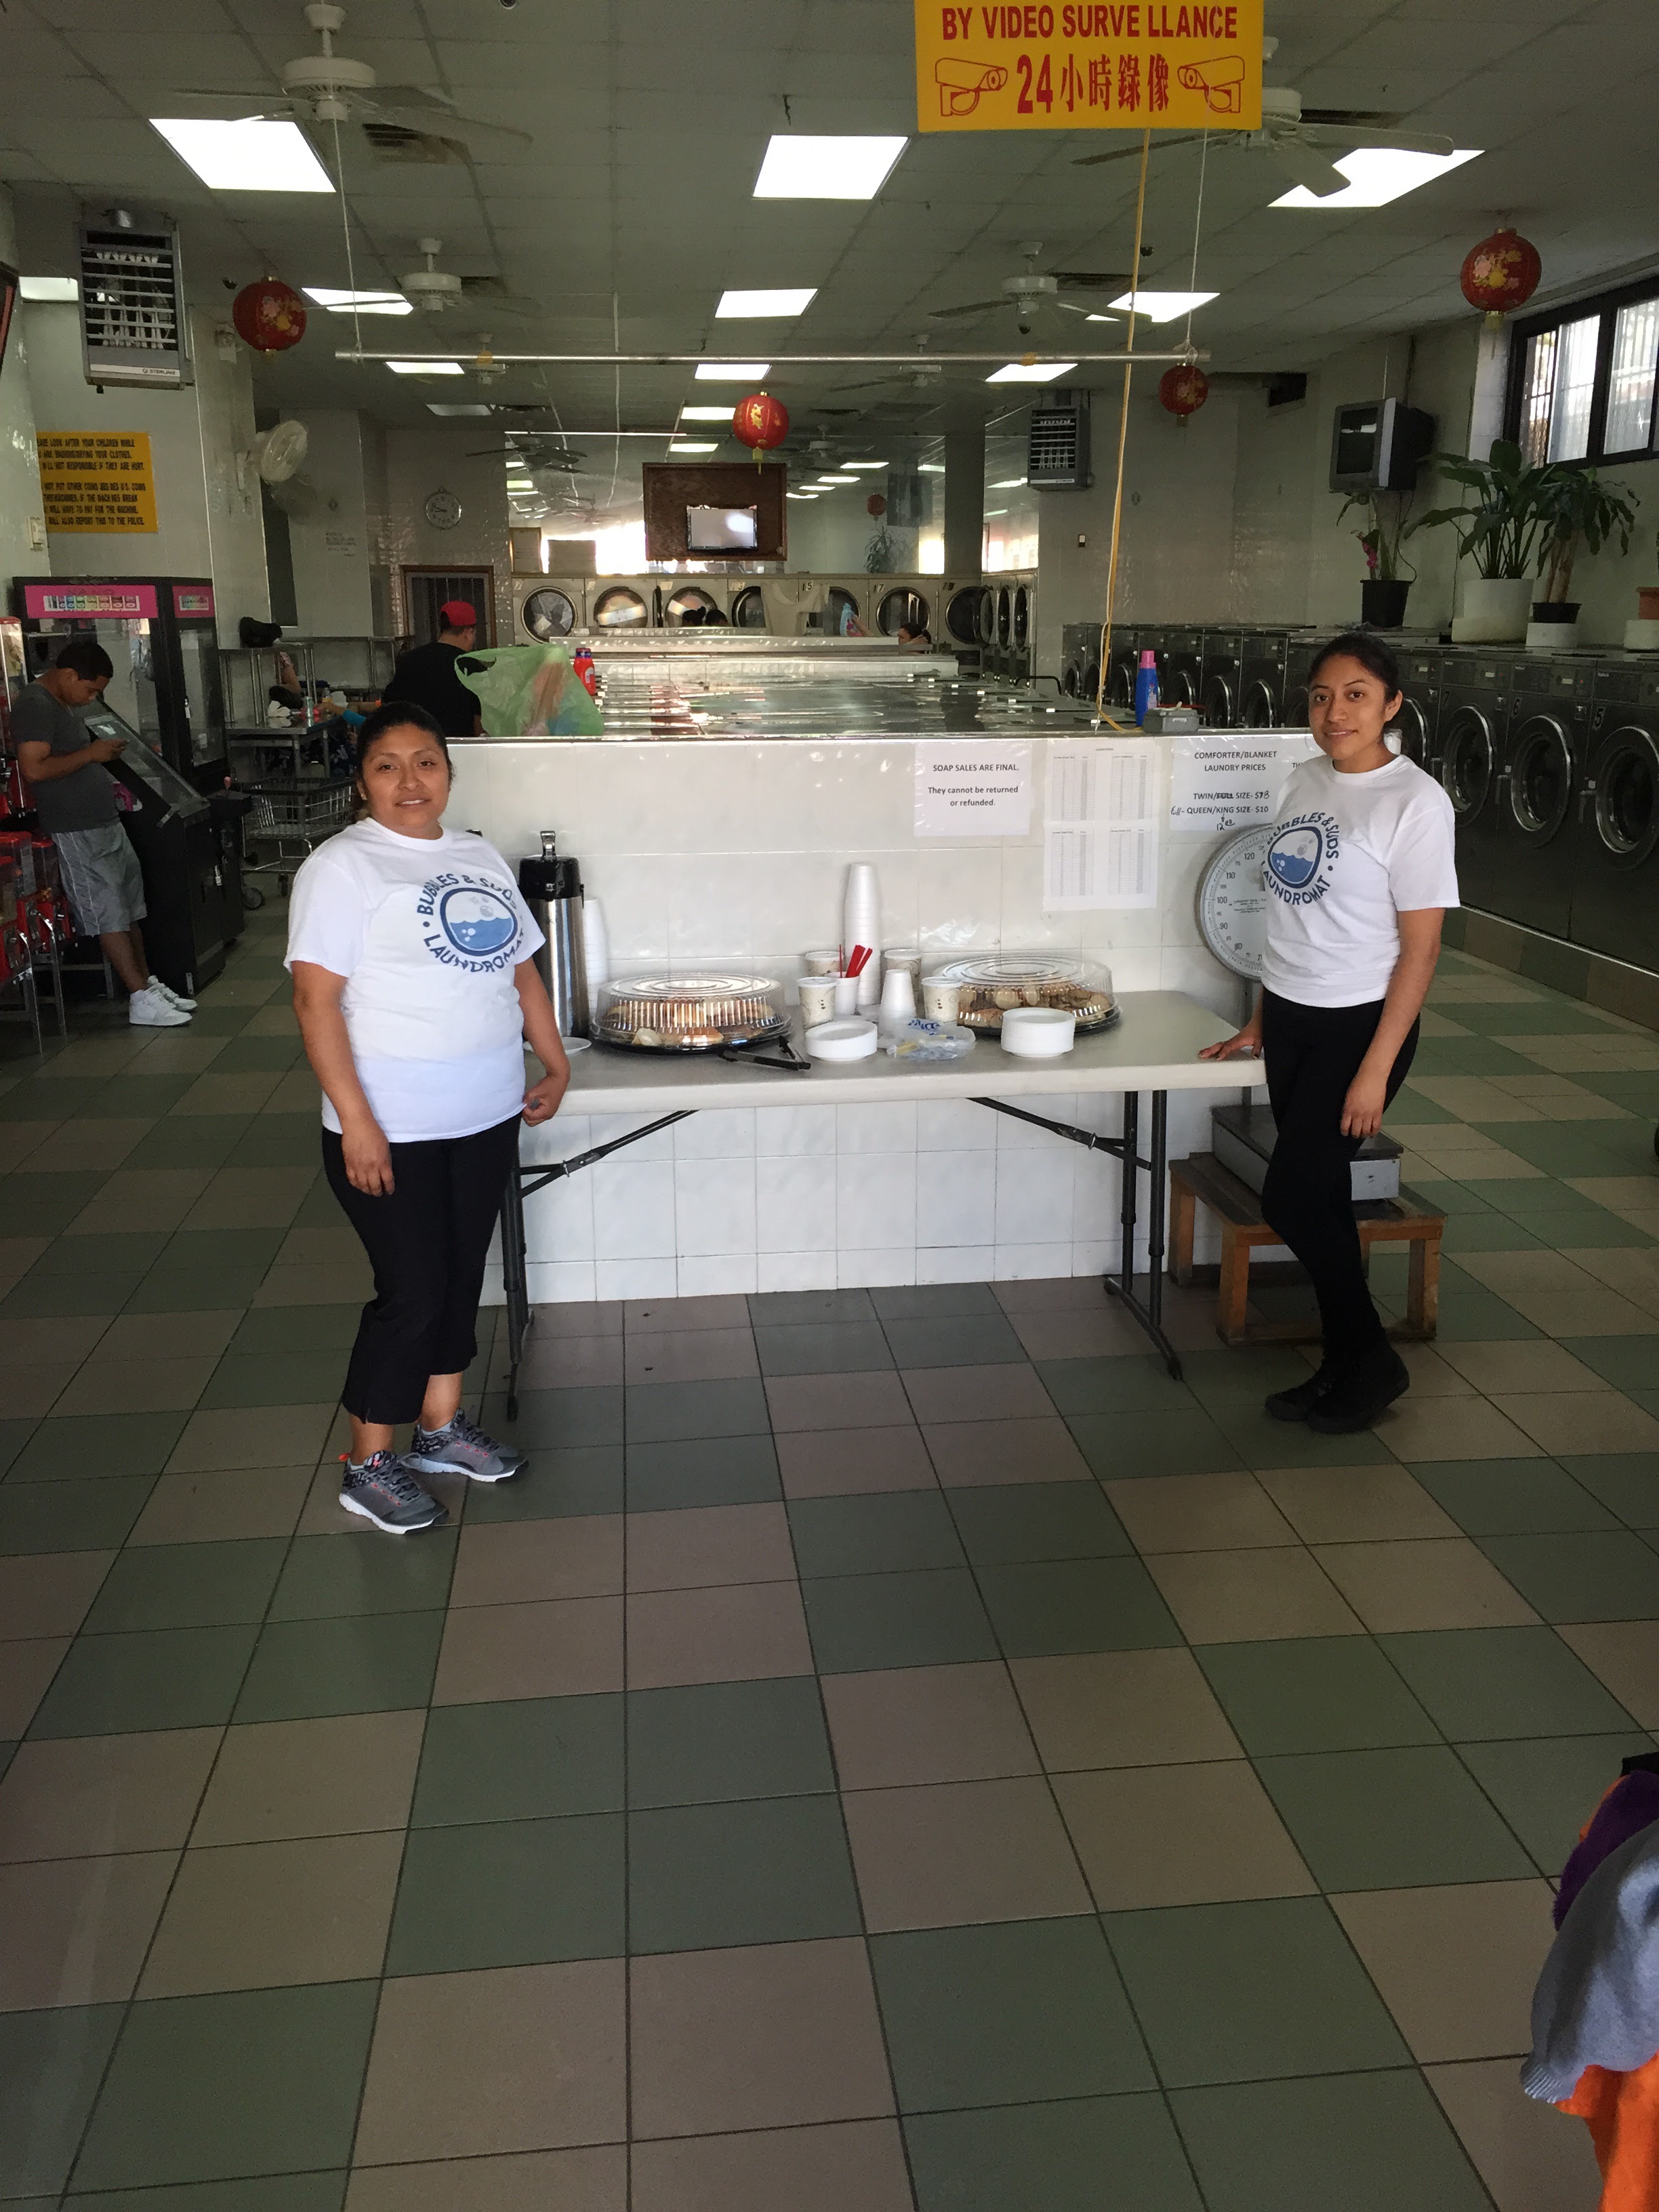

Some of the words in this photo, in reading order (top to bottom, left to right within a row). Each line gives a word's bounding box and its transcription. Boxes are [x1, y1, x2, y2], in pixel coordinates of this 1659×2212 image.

[942, 7, 973, 40] BY
[982, 5, 1054, 39] VIDEO
[802, 581, 813, 592] 15
[1595, 708, 1604, 727] 5
[1195, 751, 1277, 759] COMFORTER/BLANKET
[928, 787, 945, 795] They
[1321, 817, 1334, 827] &
[1326, 825, 1340, 859] SUDS
[1244, 852, 1255, 860] 120
[1227, 872, 1235, 880] 110
[417, 874, 459, 916] BUBBLES
[462, 875, 476, 884] &
